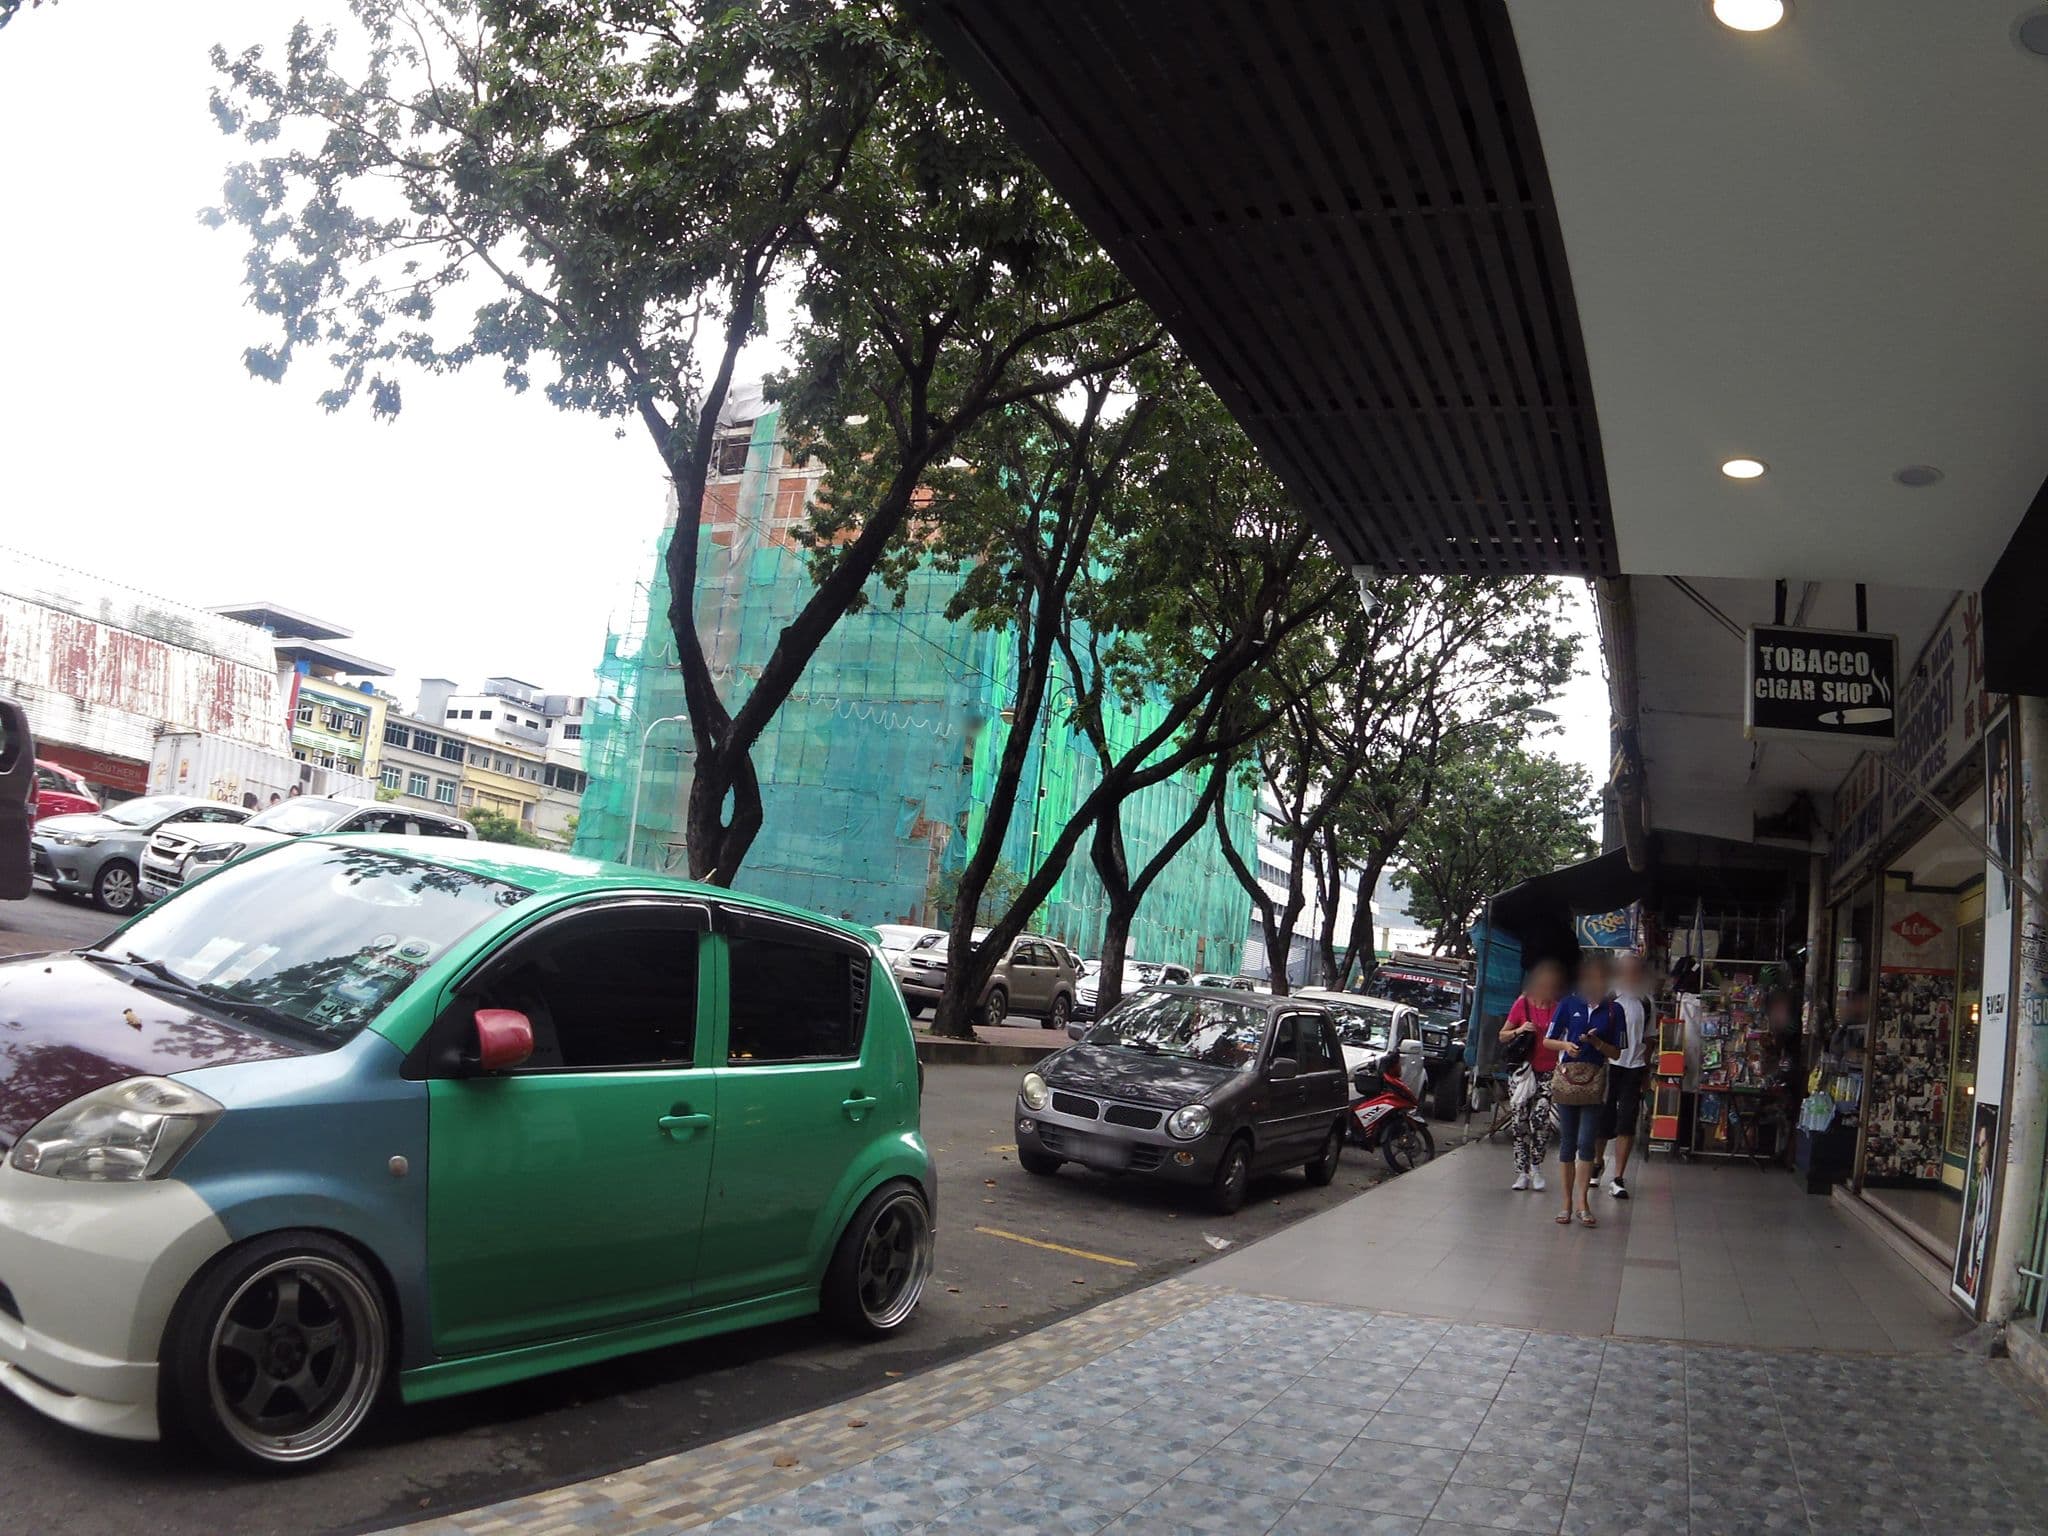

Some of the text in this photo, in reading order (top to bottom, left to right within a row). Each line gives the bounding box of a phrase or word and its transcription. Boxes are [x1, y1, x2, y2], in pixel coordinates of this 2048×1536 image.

[1760, 646, 1870, 677] TOBACCO
[1755, 678, 1873, 704] CIGAR SHOP
[1402, 973, 1434, 984] ISUZU
